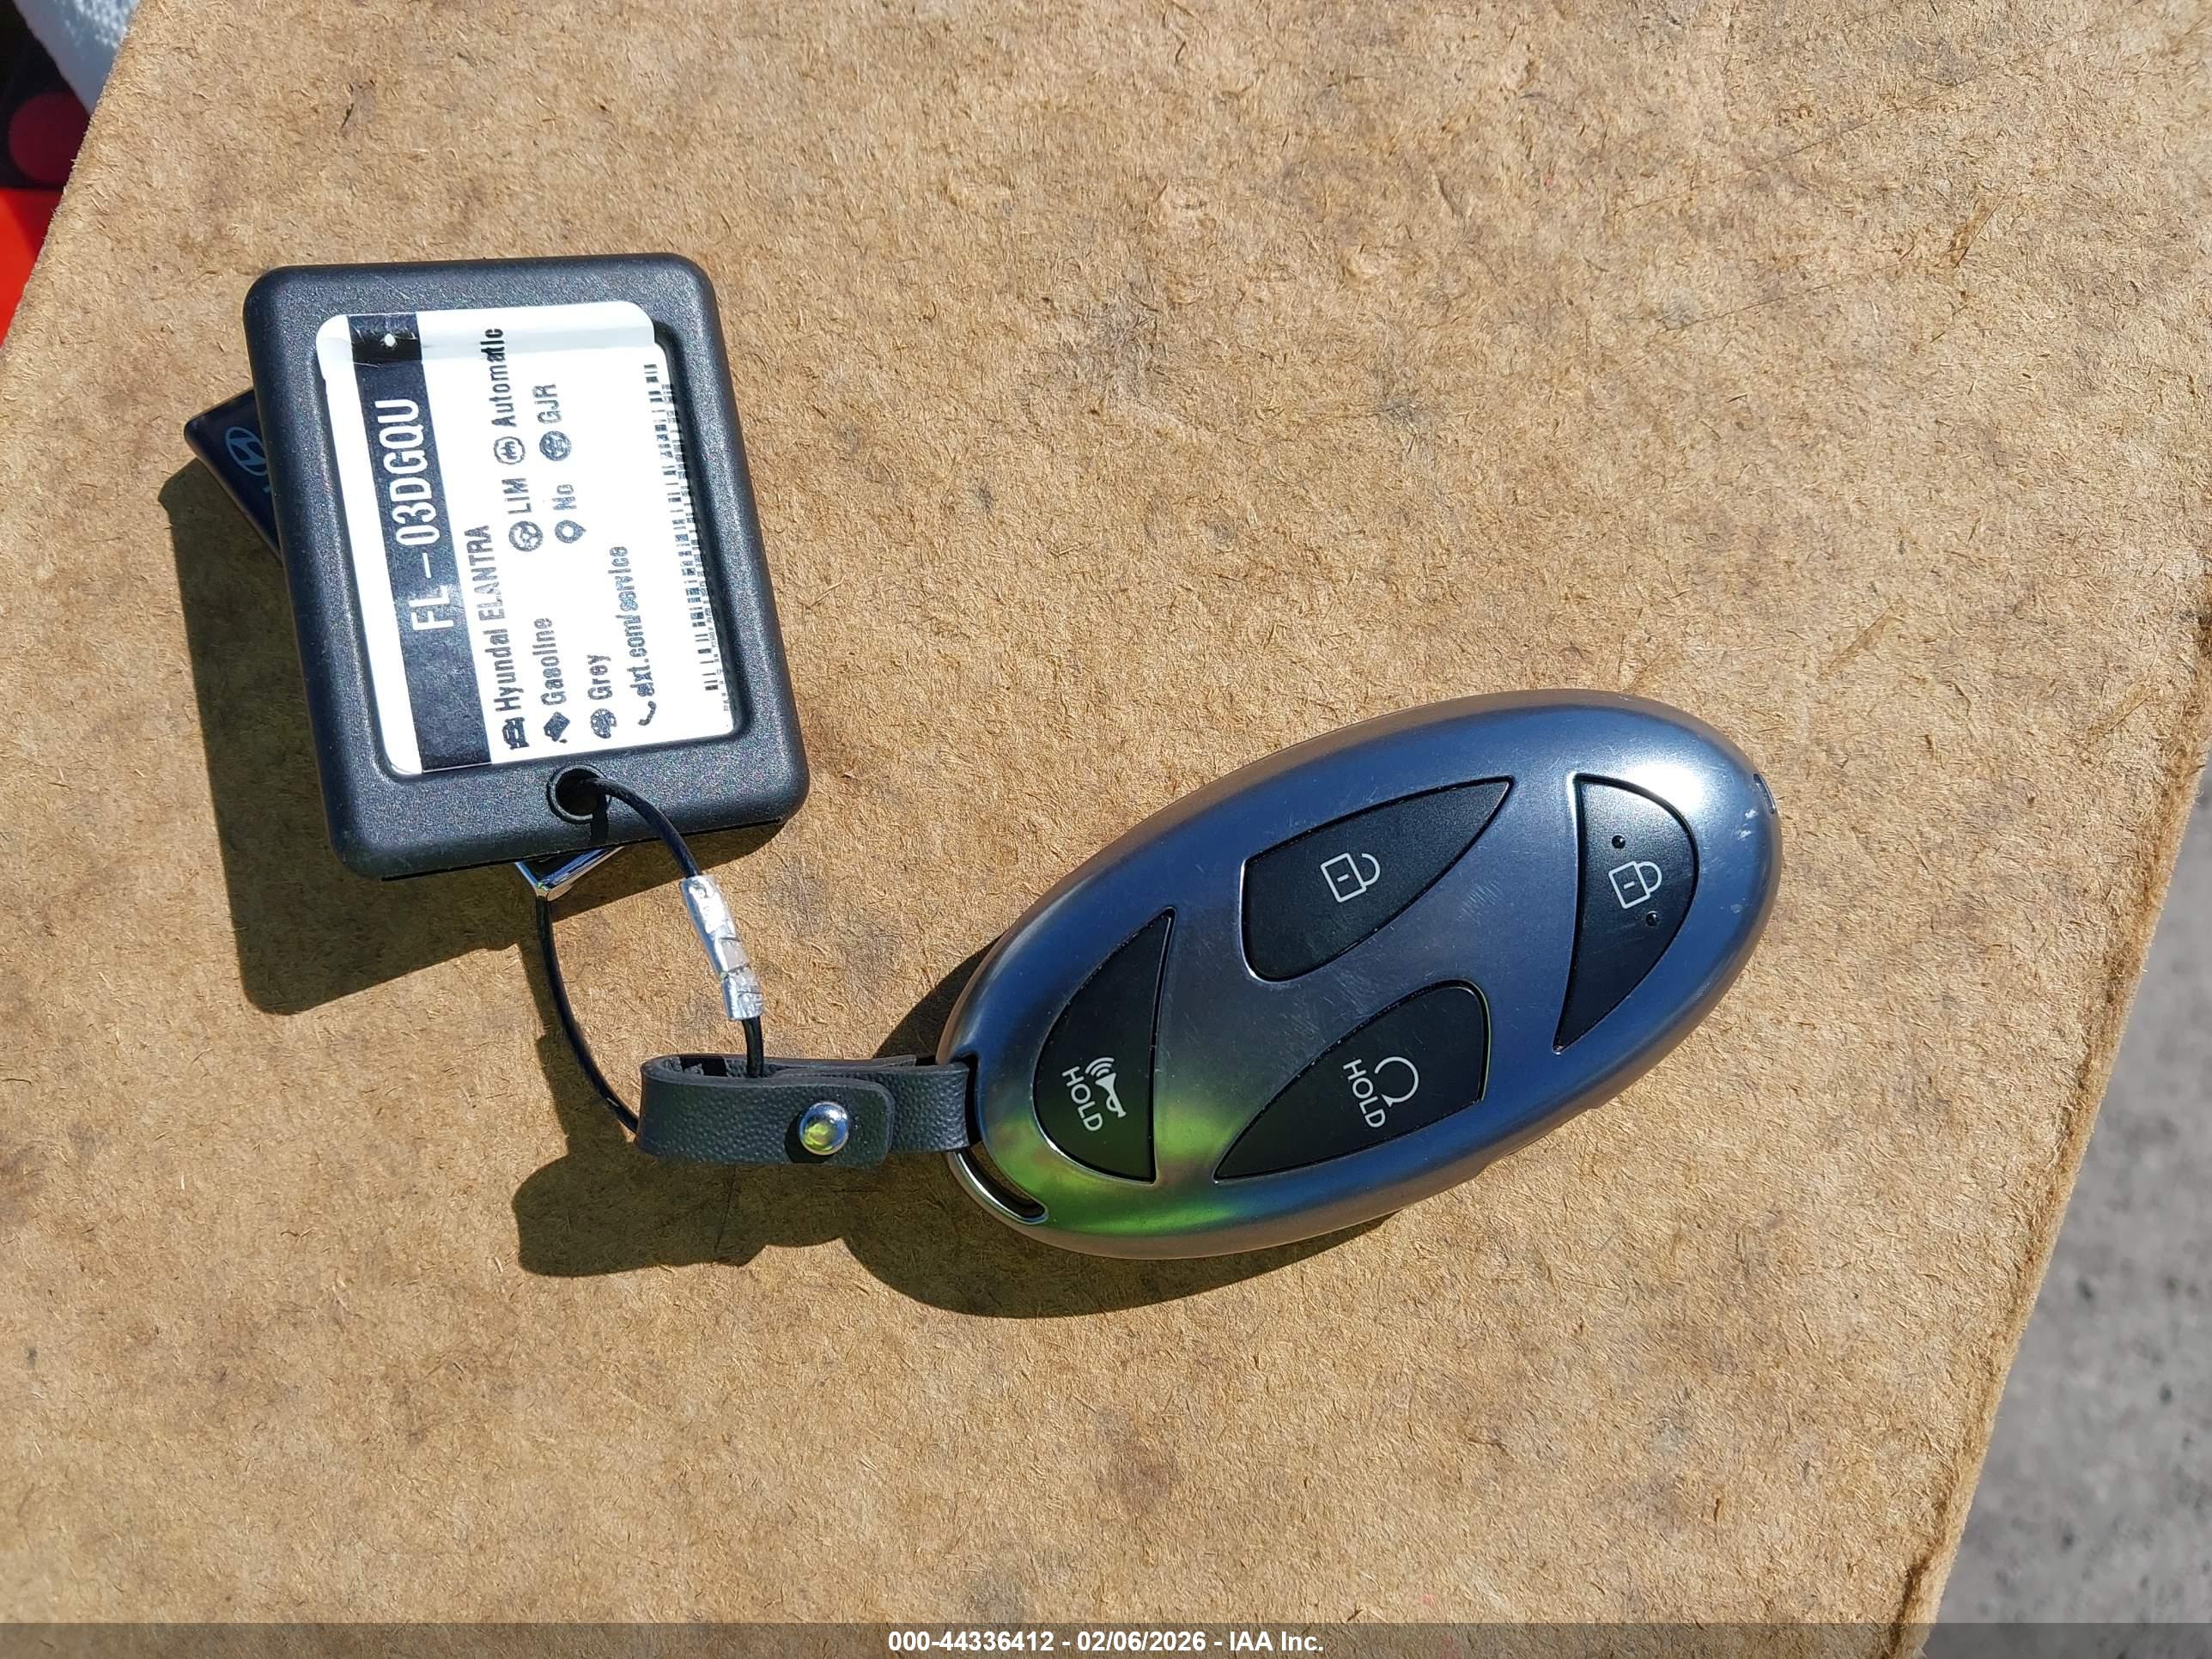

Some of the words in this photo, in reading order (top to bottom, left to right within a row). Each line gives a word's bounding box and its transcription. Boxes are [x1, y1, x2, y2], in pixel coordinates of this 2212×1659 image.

[480, 328, 518, 428] Automatic
[374, 398, 441, 547] 03DGQU
[501, 477, 532, 514] LIM
[551, 483, 578, 511] No
[408, 584, 454, 631] FL
[464, 525, 506, 622] ELANTRA
[483, 628, 525, 712] Hyundai
[532, 617, 568, 706] Gasoline
[586, 653, 614, 701] Grey
[1061, 1066, 1103, 1131] HOLD
[1342, 1058, 1386, 1128] HOLD
